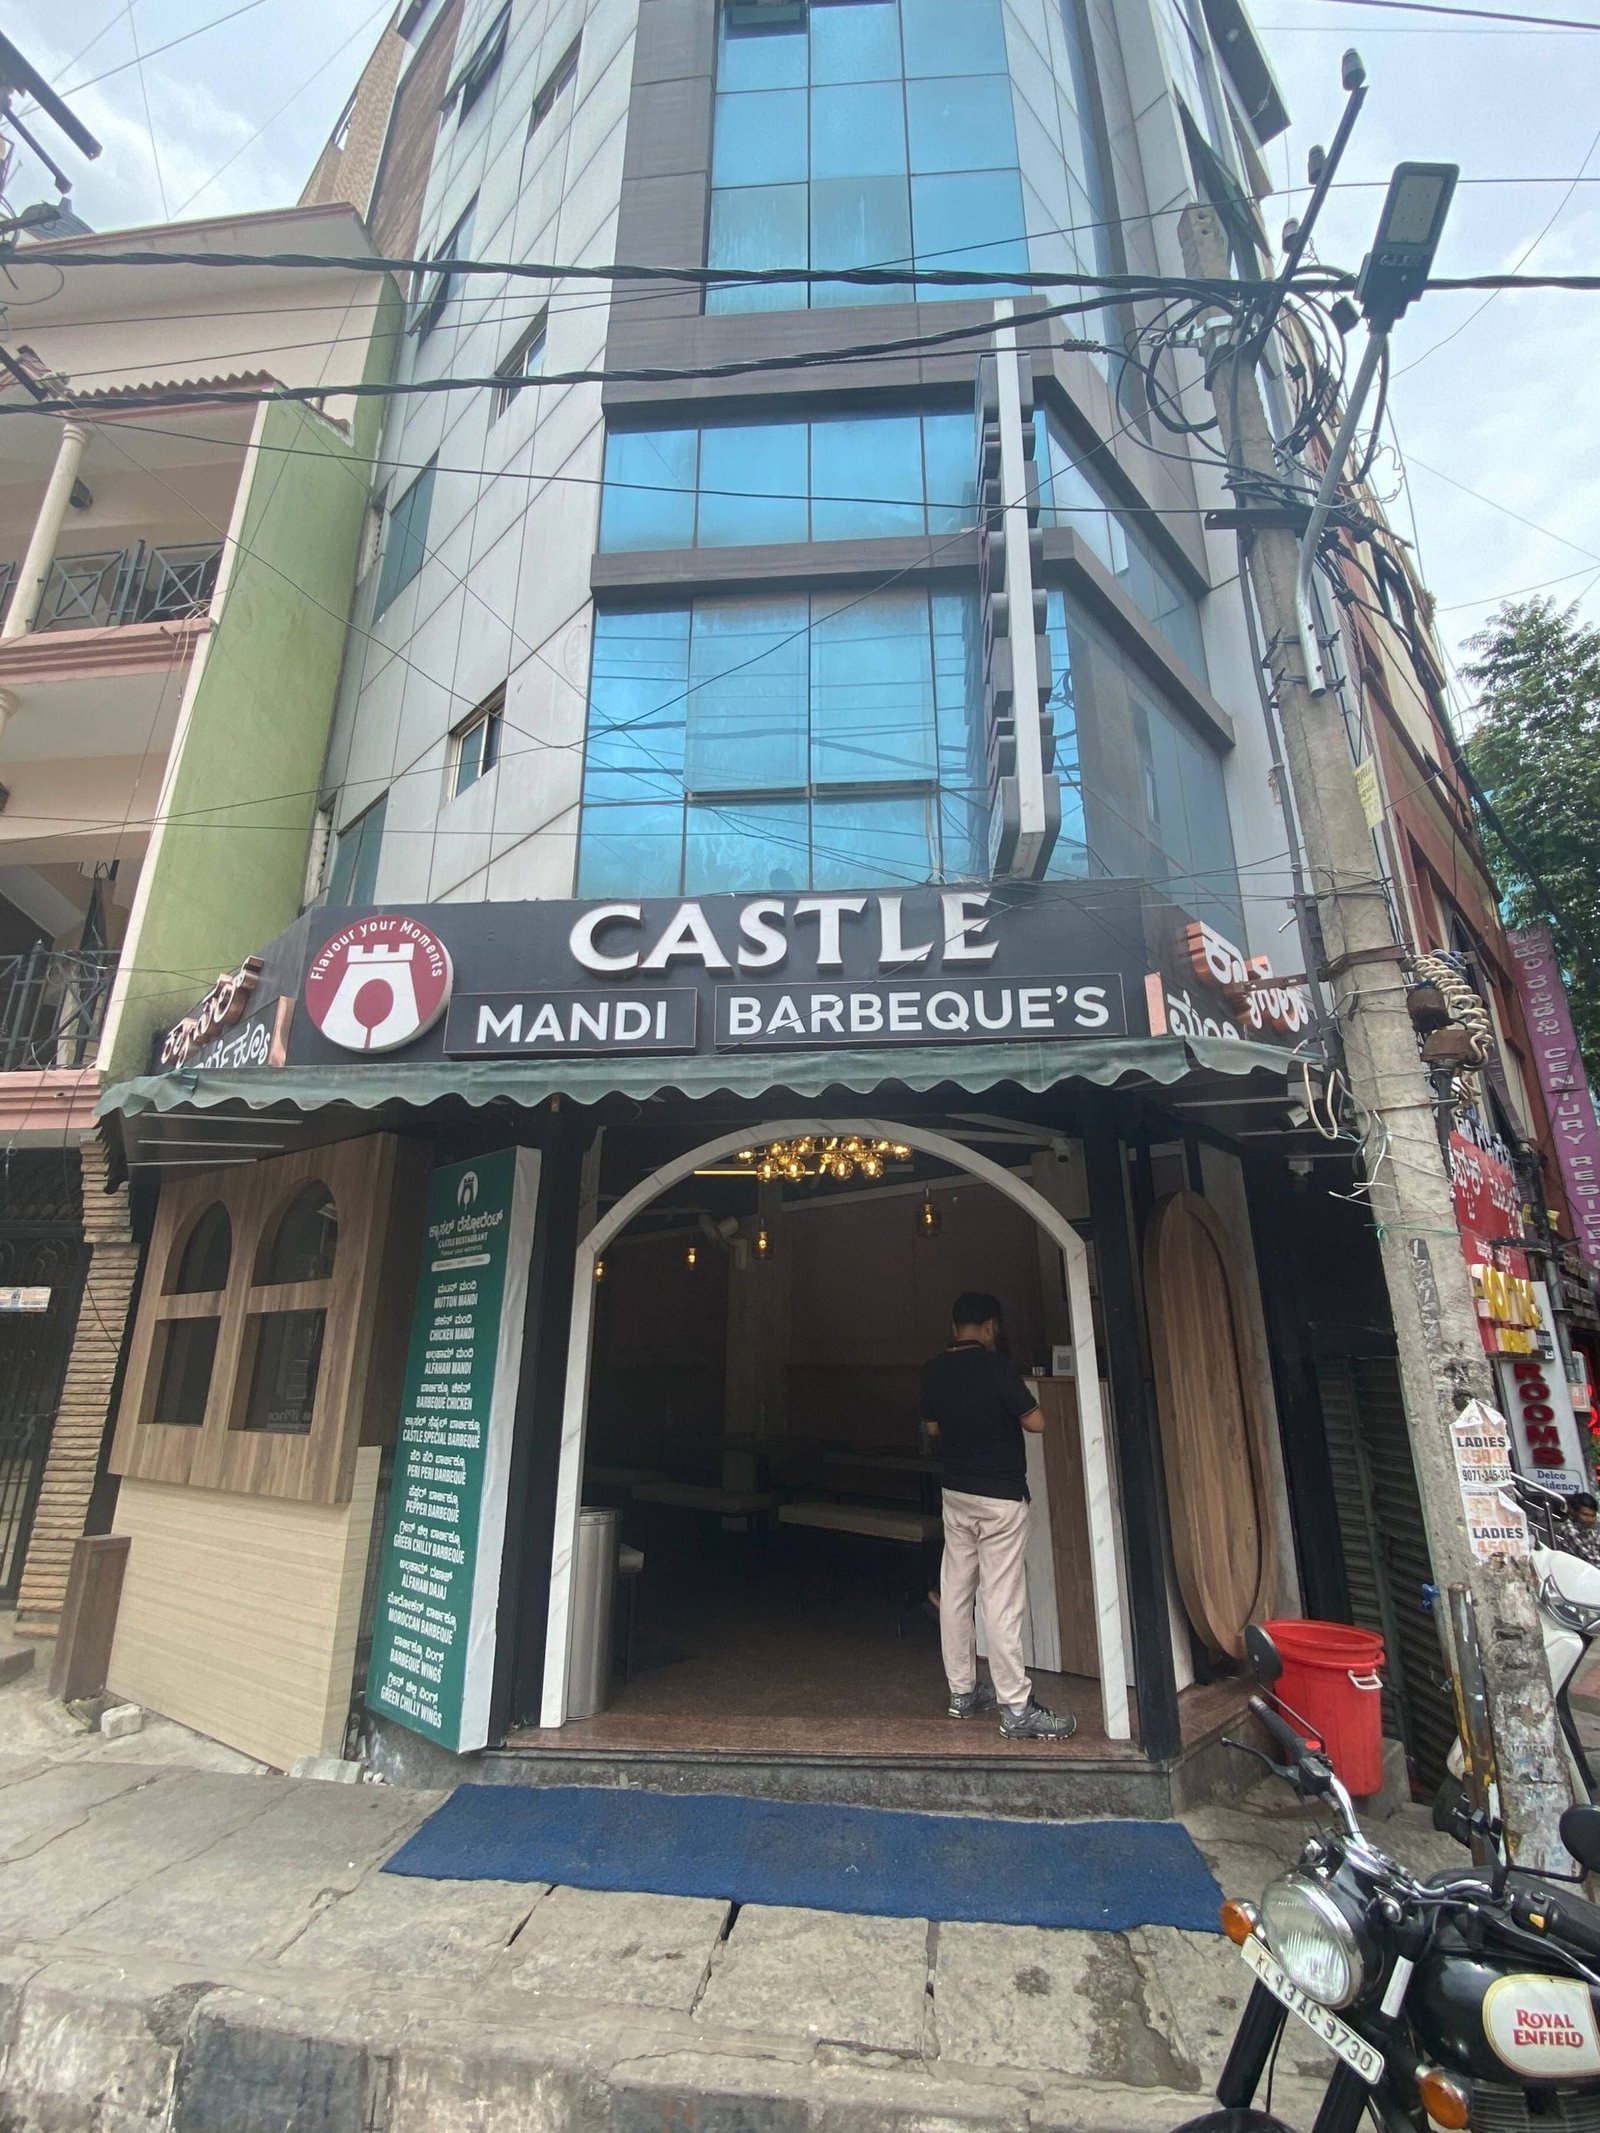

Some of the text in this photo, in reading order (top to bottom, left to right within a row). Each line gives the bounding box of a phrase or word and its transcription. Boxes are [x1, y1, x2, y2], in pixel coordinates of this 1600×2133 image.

[568, 892, 1000, 973] CASTLE
[310, 920, 443, 980] Flavour your Moments
[475, 985, 1111, 1044] MANDI BARBEQUE'S
[457, 1293, 479, 1307] MANDI
[429, 1327, 475, 1342] CHICKEN MANDI
[451, 1362, 472, 1375] MANDI
[1456, 1436, 1506, 1448] LADIES
[407, 1464, 421, 1478] PERI
[420, 1466, 435, 1480] PERI
[1536, 1470, 1567, 1481] Delco
[405, 1499, 427, 1518] PEPPER
[1472, 1527, 1524, 1539] LADIES
[393, 1534, 465, 1565] GREEN CHILLY BARBEQUE
[388, 1607, 453, 1645] MOROCCAN BARBEQUE
[389, 1648, 442, 1683] BARBEQUE WINGS
[380, 1685, 442, 1729] GREEN CHILLY WINGS
[1297, 1997, 1321, 2025] AC
[1515, 2008, 1575, 2029] ROYAL
[1513, 2028, 1584, 2048] ENFIELD
